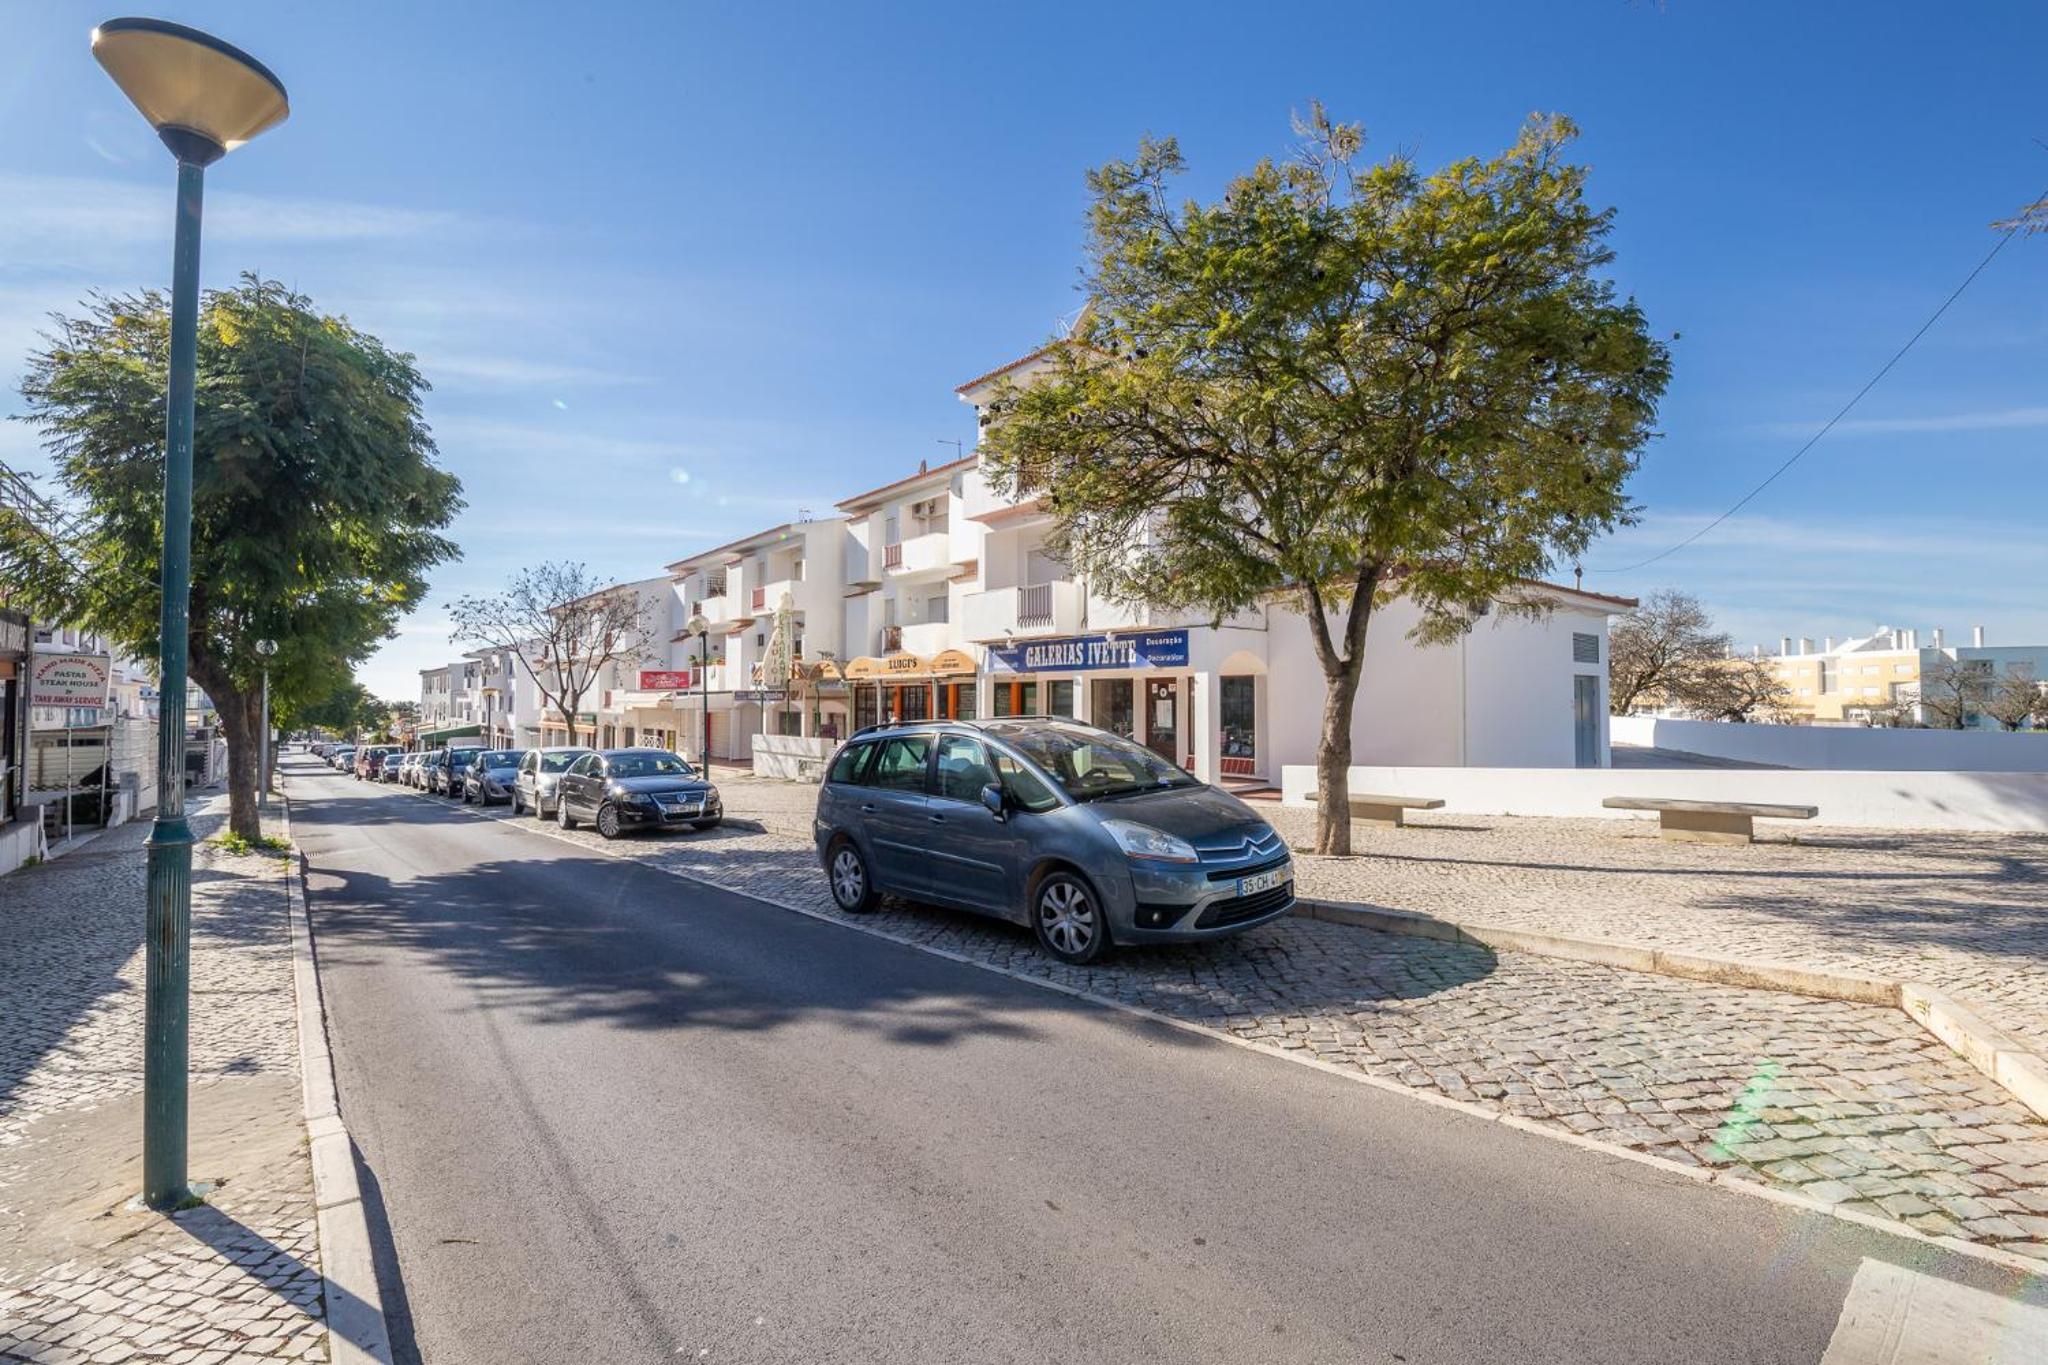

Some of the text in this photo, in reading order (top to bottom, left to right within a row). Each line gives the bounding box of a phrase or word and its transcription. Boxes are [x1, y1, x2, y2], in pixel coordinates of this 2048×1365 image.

[1146, 636, 1182, 646] Decoração
[1026, 640, 1137, 668] GALERIAS IVETTE
[888, 658, 918, 669] LUIGI'S
[34, 695, 103, 705] TAKE AWAY SERVICE
